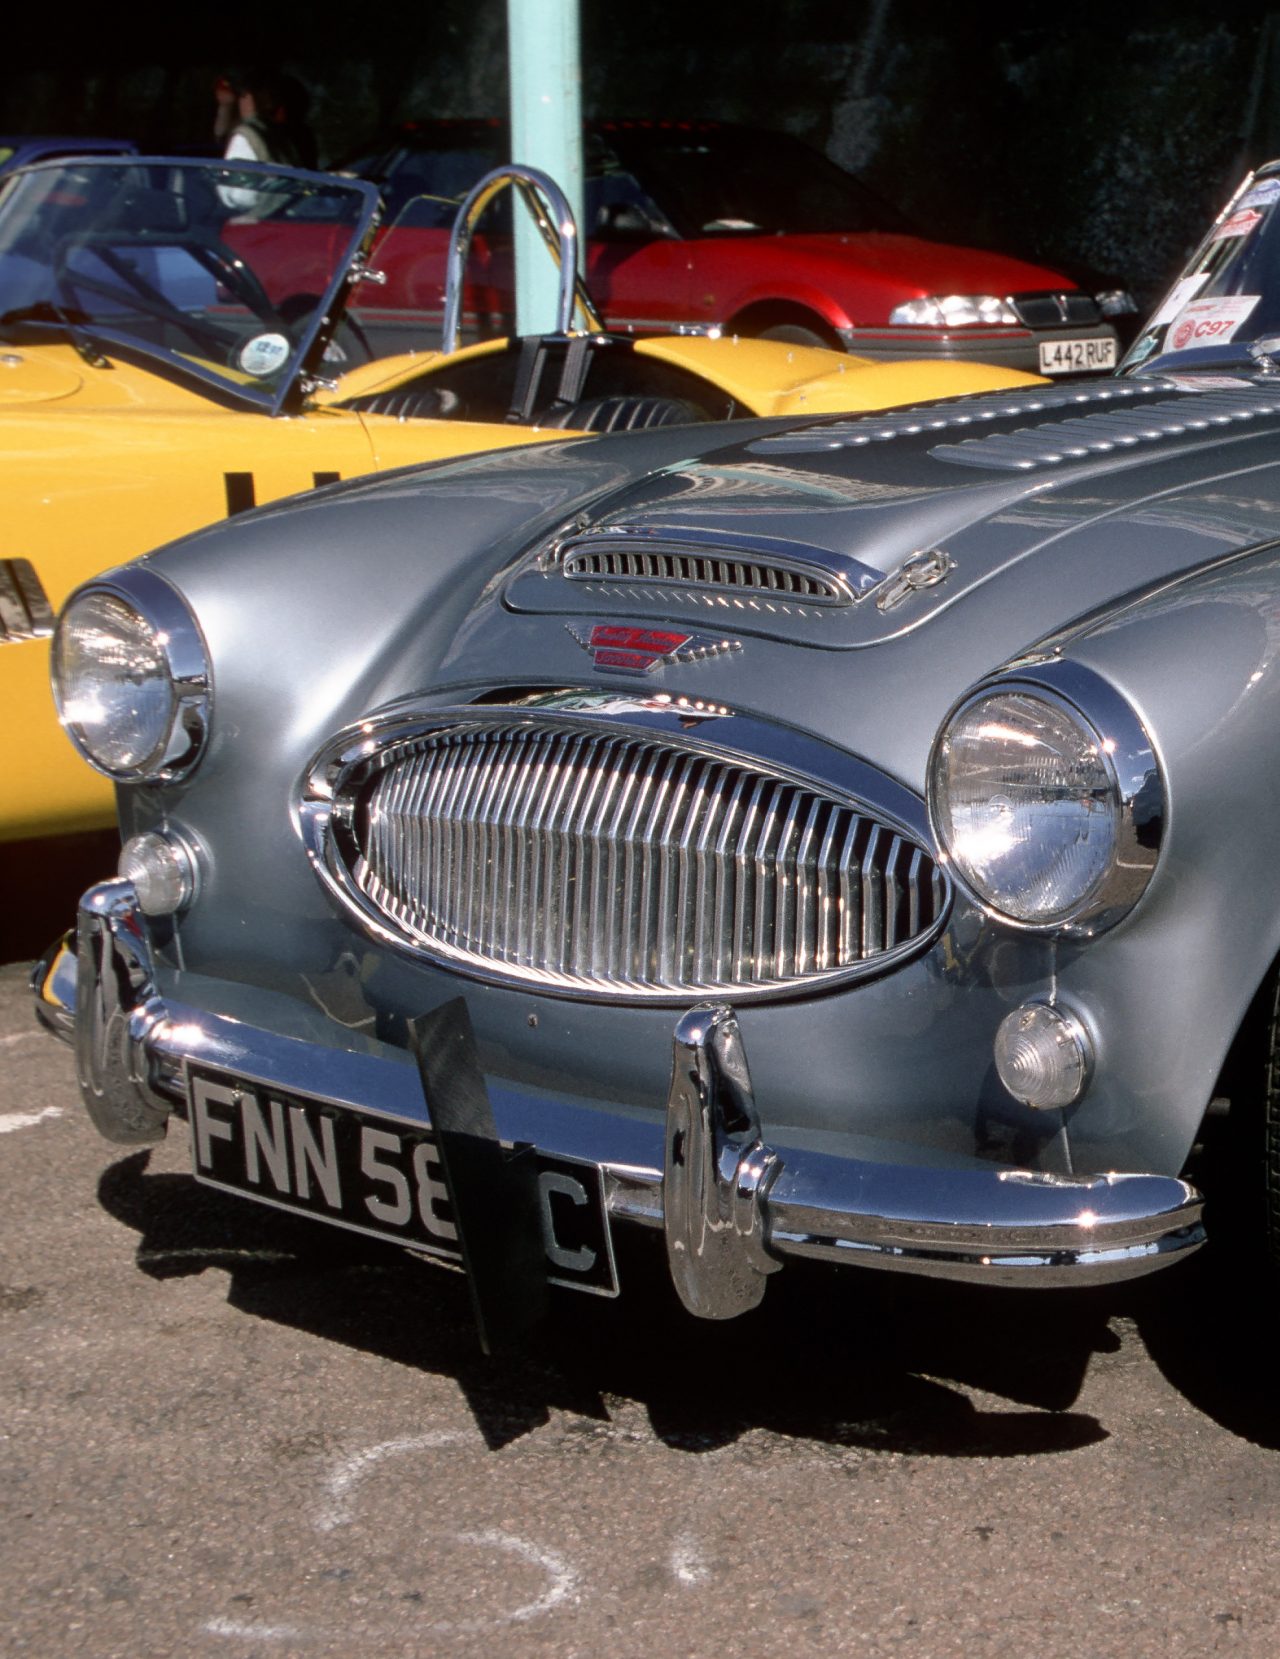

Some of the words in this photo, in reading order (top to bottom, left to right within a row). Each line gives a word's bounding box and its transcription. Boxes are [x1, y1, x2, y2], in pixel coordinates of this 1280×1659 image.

[1194, 320, 1234, 338] C97
[1042, 343, 1084, 368] L442
[1086, 341, 1113, 364] RUF
[192, 1076, 343, 1210] FNN
[360, 1125, 459, 1241] 58
[537, 1170, 598, 1272] C
